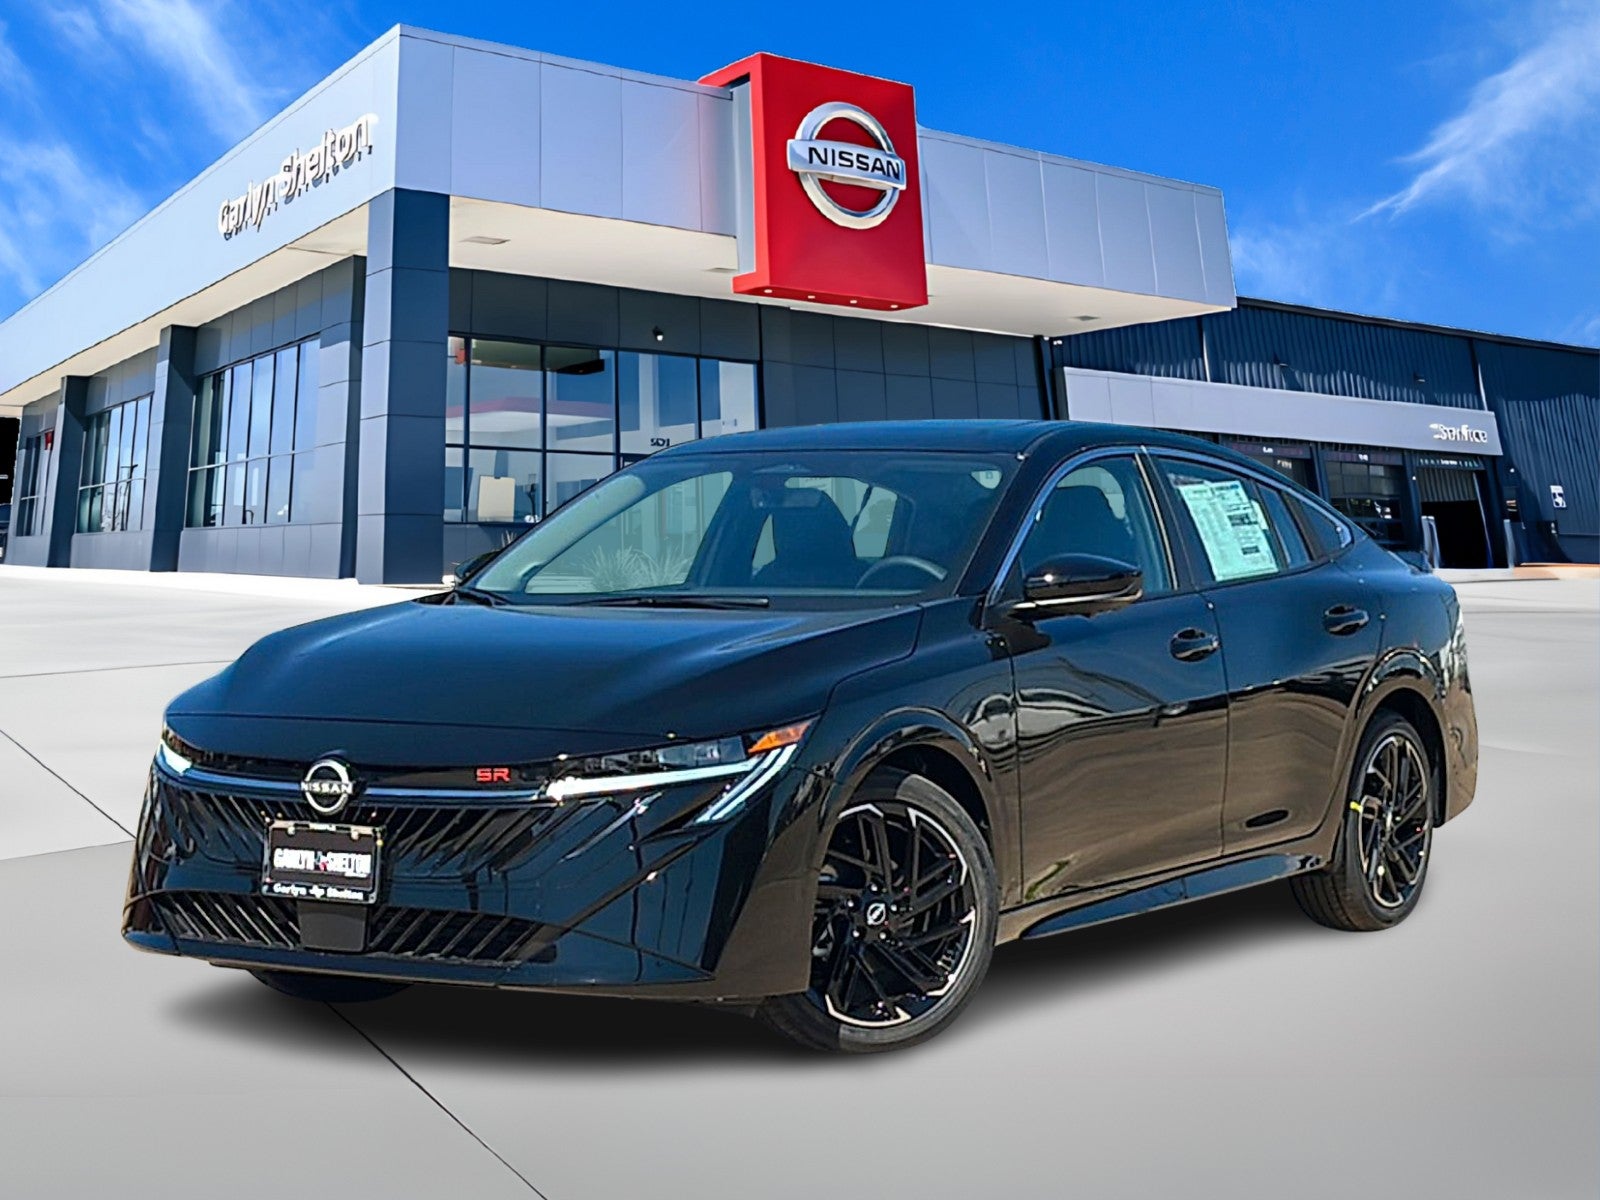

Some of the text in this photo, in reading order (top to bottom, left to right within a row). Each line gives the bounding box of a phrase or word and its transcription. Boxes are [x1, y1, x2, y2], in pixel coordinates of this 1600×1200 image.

[808, 147, 900, 180] NISSAN
[476, 767, 511, 782] SR
[300, 780, 353, 795] NISSAN
